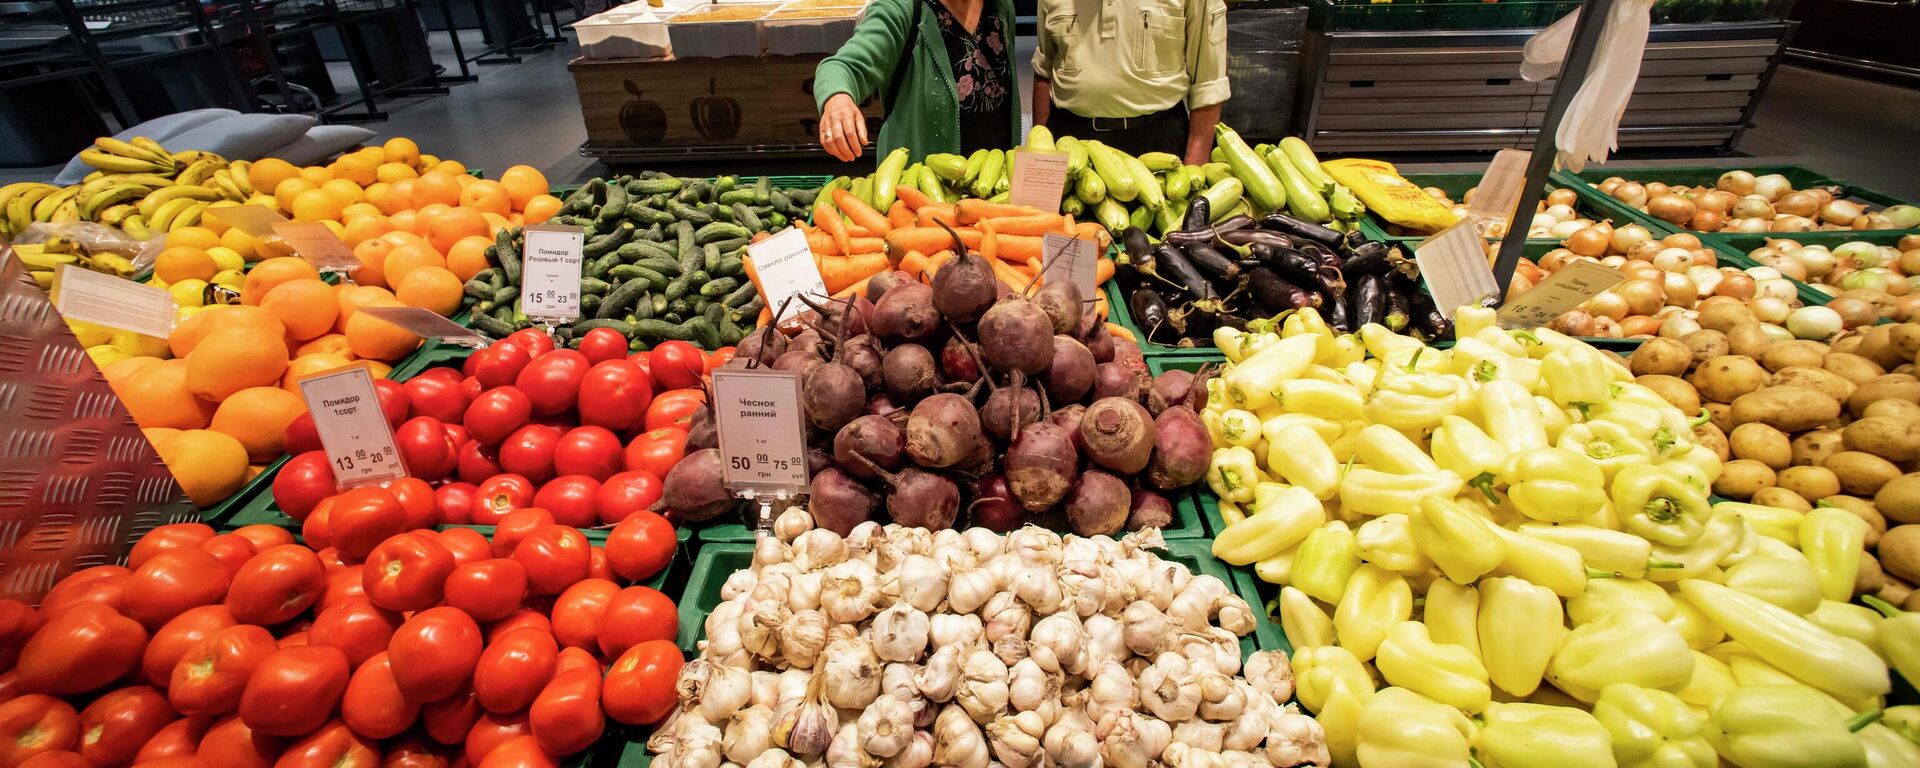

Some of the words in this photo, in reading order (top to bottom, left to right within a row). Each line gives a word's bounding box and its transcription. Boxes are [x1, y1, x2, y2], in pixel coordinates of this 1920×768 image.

[758, 258, 782, 271] Свекла
[529, 292, 543, 303] 15
[557, 295, 567, 303] 23
[323, 395, 360, 408] Помидор
[739, 398, 775, 407] Чеснок
[334, 406, 357, 416] 1сорт
[740, 410, 777, 418] ранний
[336, 456, 354, 471] 13
[355, 449, 366, 458] 00
[370, 452, 383, 463] 20
[383, 446, 392, 454] 00
[731, 456, 750, 470] 50
[757, 453, 768, 462] 00
[773, 460, 788, 470] 75
